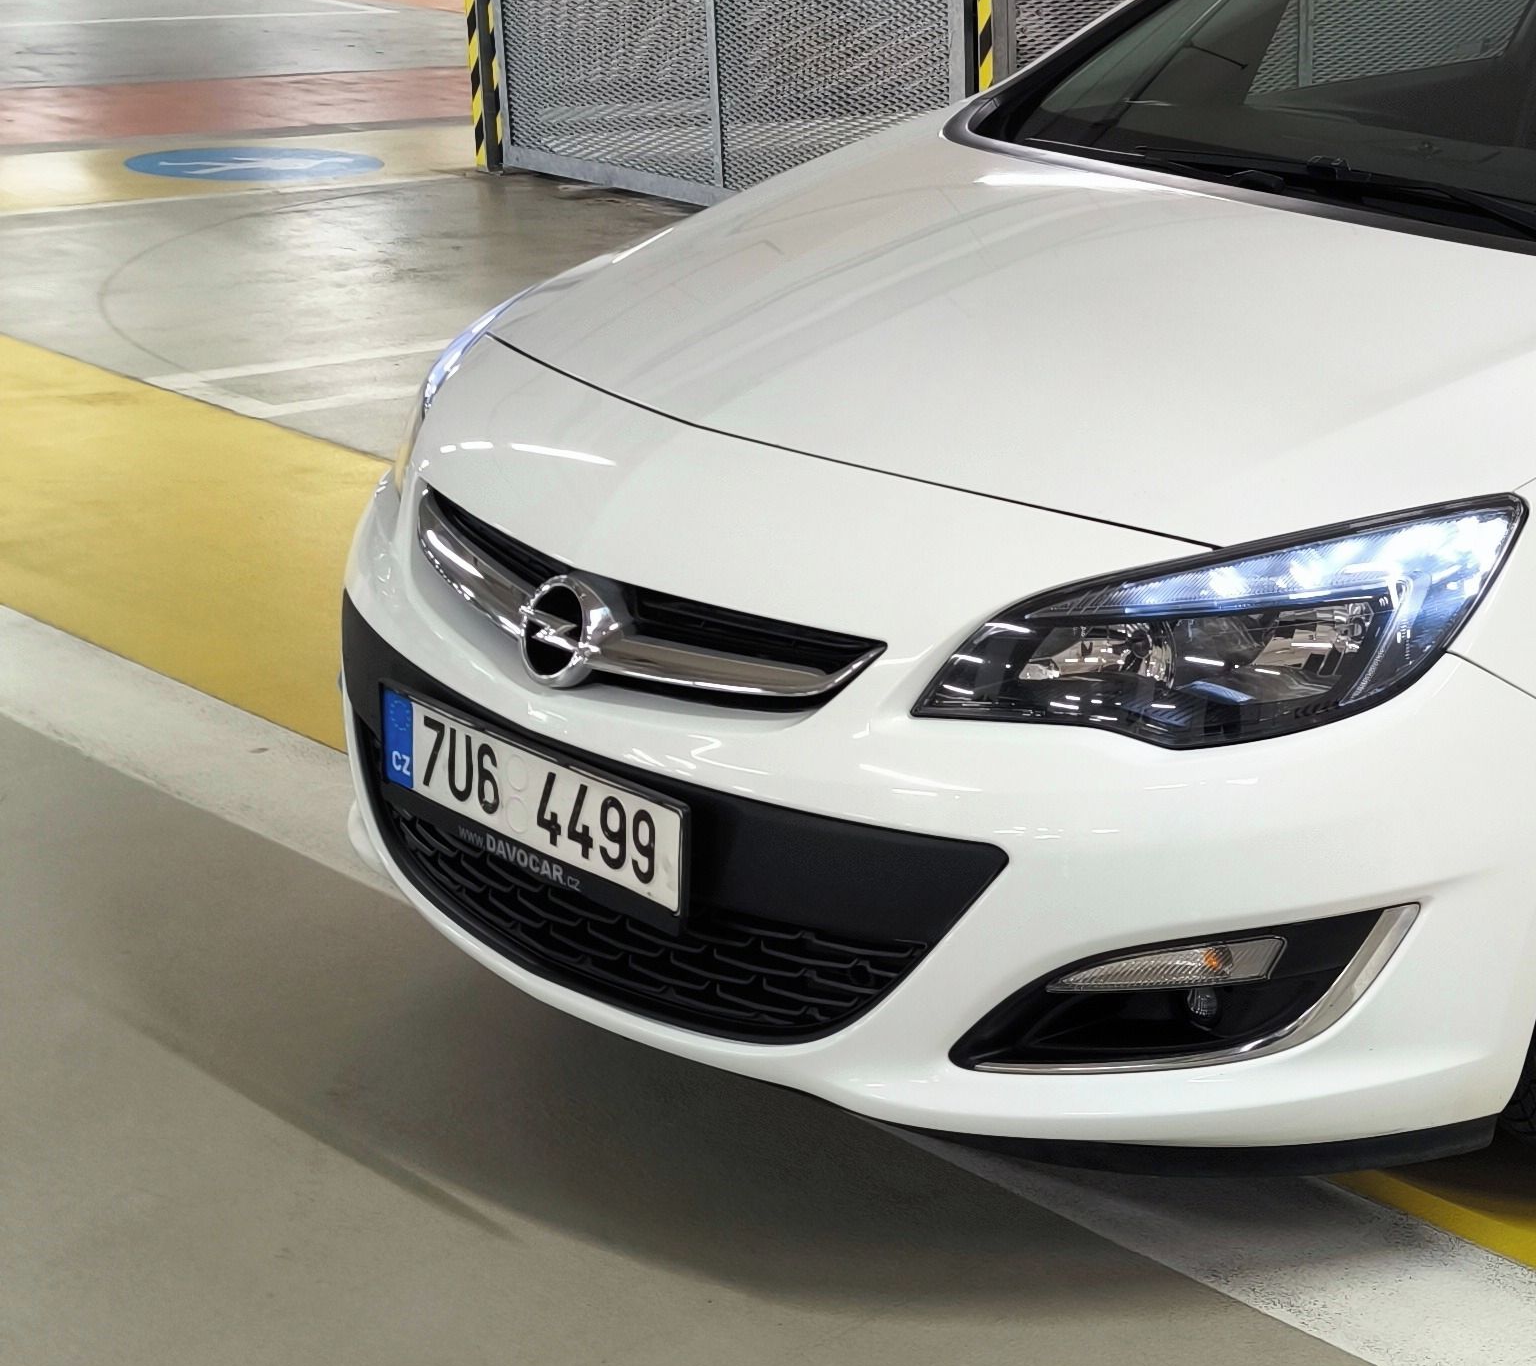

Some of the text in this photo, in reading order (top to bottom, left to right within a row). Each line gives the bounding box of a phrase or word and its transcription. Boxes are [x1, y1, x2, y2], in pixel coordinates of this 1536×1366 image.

[391, 750, 411, 776] CZ
[422, 715, 656, 885] 7U6 4499
